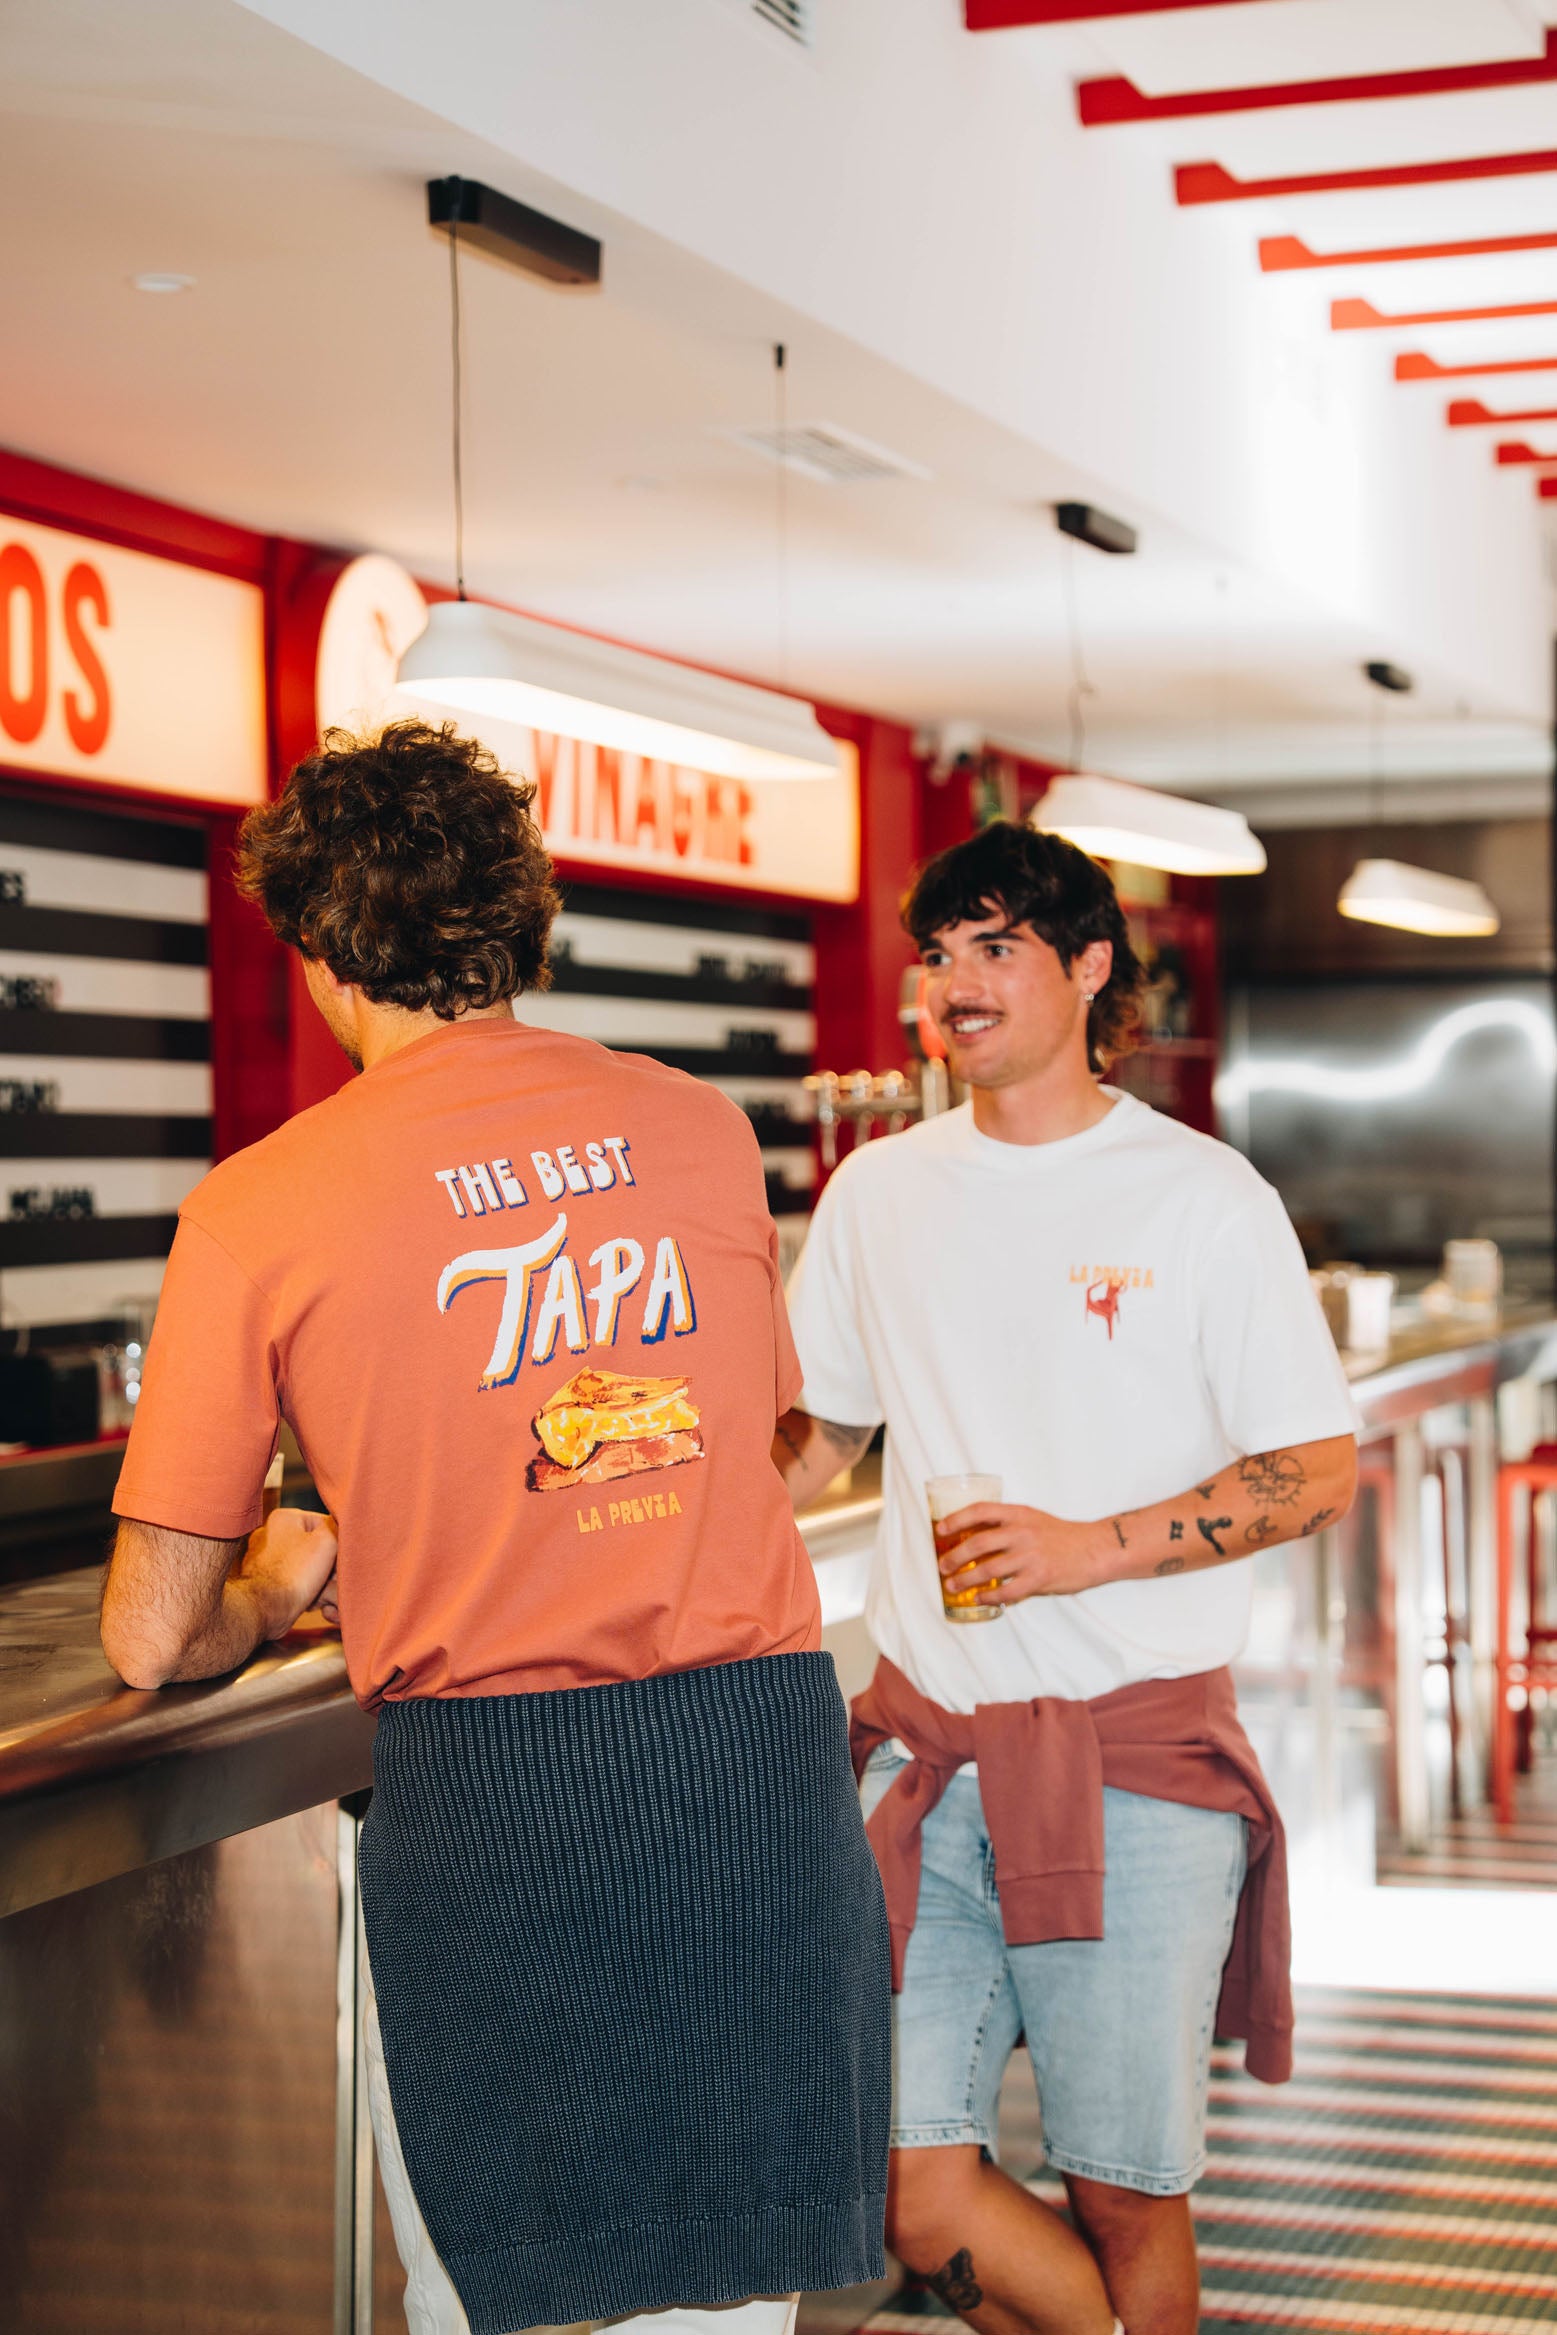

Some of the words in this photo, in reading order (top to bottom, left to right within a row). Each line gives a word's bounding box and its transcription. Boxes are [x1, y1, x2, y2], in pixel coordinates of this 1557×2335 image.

[0, 543, 111, 755] OS
[435, 1157, 529, 1218] THE
[531, 1136, 636, 1203] BEST
[437, 1213, 697, 1392] TAPA
[577, 1507, 603, 1533] LA
[608, 1491, 682, 1528] PREVIA
